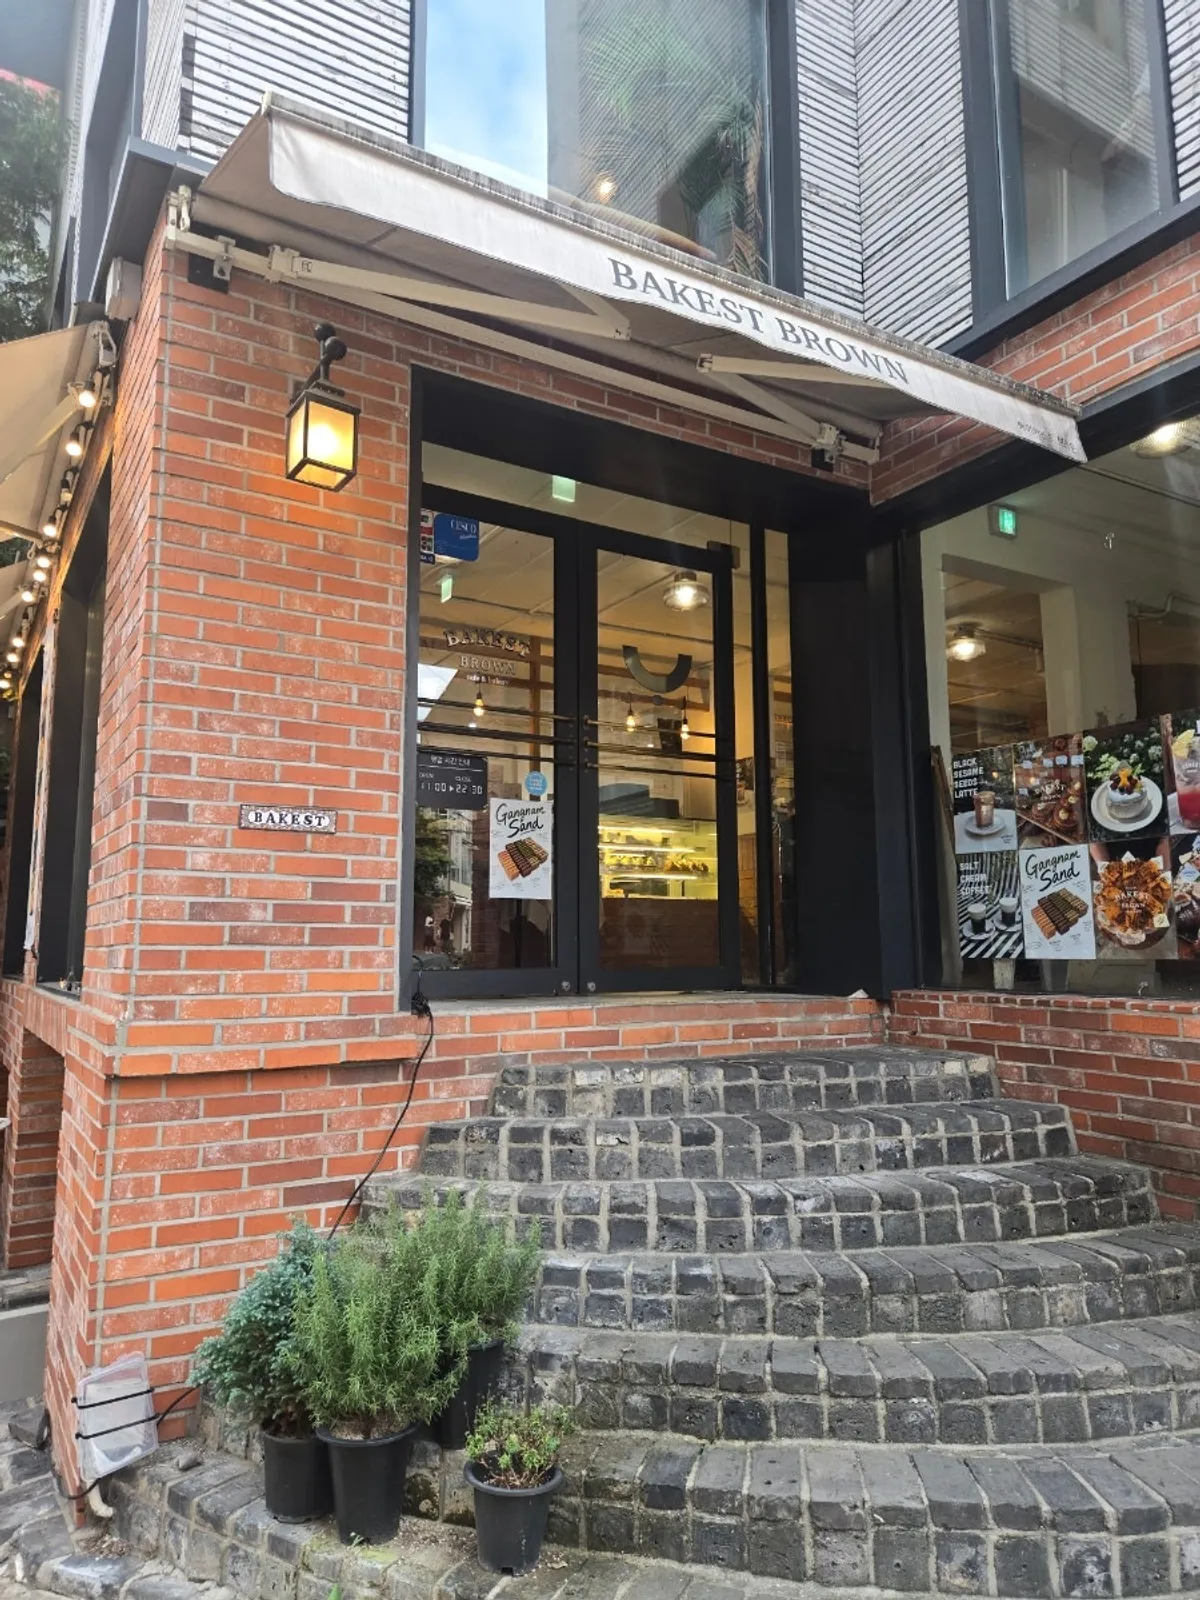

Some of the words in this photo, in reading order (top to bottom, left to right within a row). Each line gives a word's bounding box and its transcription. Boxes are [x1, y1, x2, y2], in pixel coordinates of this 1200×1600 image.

[608, 257, 765, 334] BAKEST
[775, 317, 910, 385] BROWN
[443, 628, 531, 657] BAKEST
[460, 655, 516, 675] BROWN
[953, 757, 977, 769] BLACK
[953, 766, 984, 778] SESAME
[954, 788, 978, 799] LATTE
[254, 812, 325, 826] BAKEST
[507, 817, 544, 838] Sand
[1025, 850, 1081, 879] Gangnam
[1039, 861, 1081, 891] Sand
